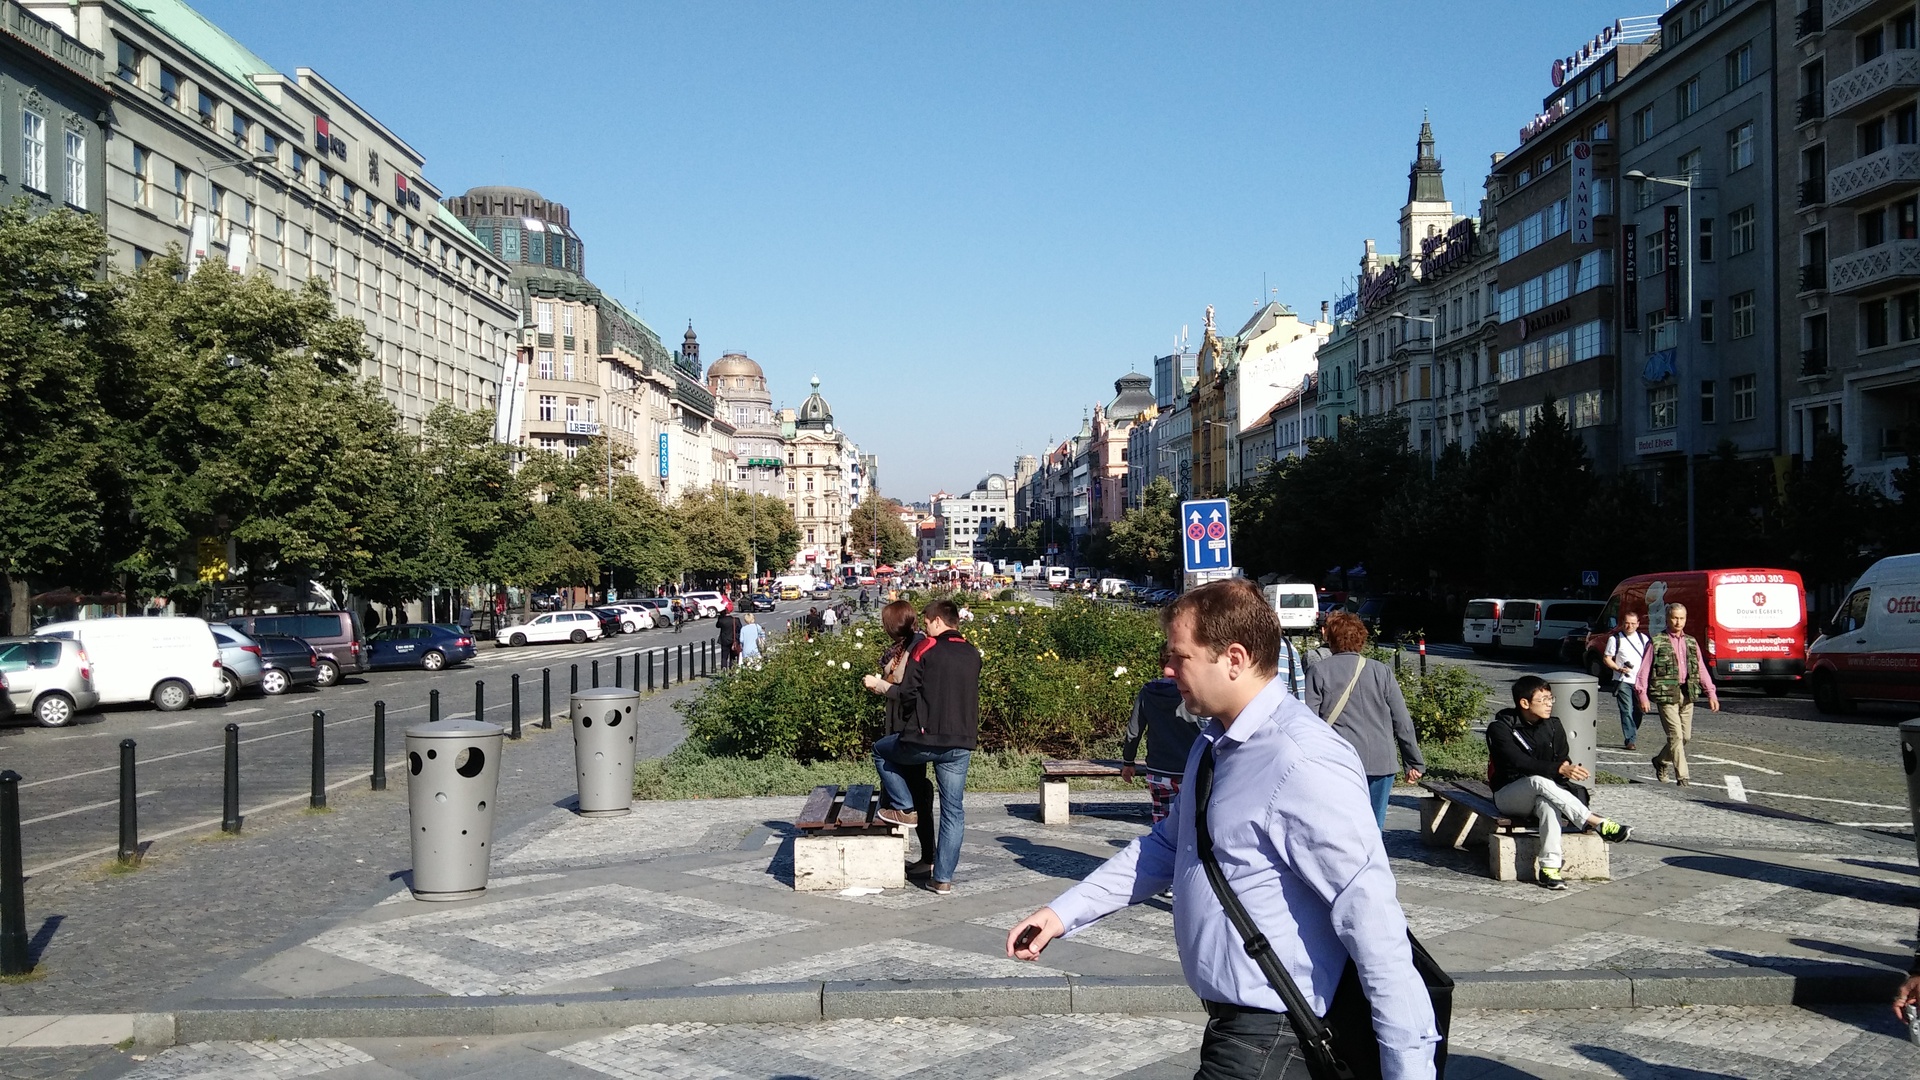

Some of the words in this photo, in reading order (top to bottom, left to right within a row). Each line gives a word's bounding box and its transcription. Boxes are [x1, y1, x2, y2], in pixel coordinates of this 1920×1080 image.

[1566, 19, 1622, 73] RAMADA
[1577, 167, 1588, 242] RAMADA
[1626, 232, 1636, 282] Elysee
[1668, 213, 1678, 266] Elysee
[1638, 440, 1654, 450] Hotel
[1750, 574, 1766, 583] 300
[1768, 574, 1784, 583] 303
[1736, 645, 1789, 653] professional.cz
